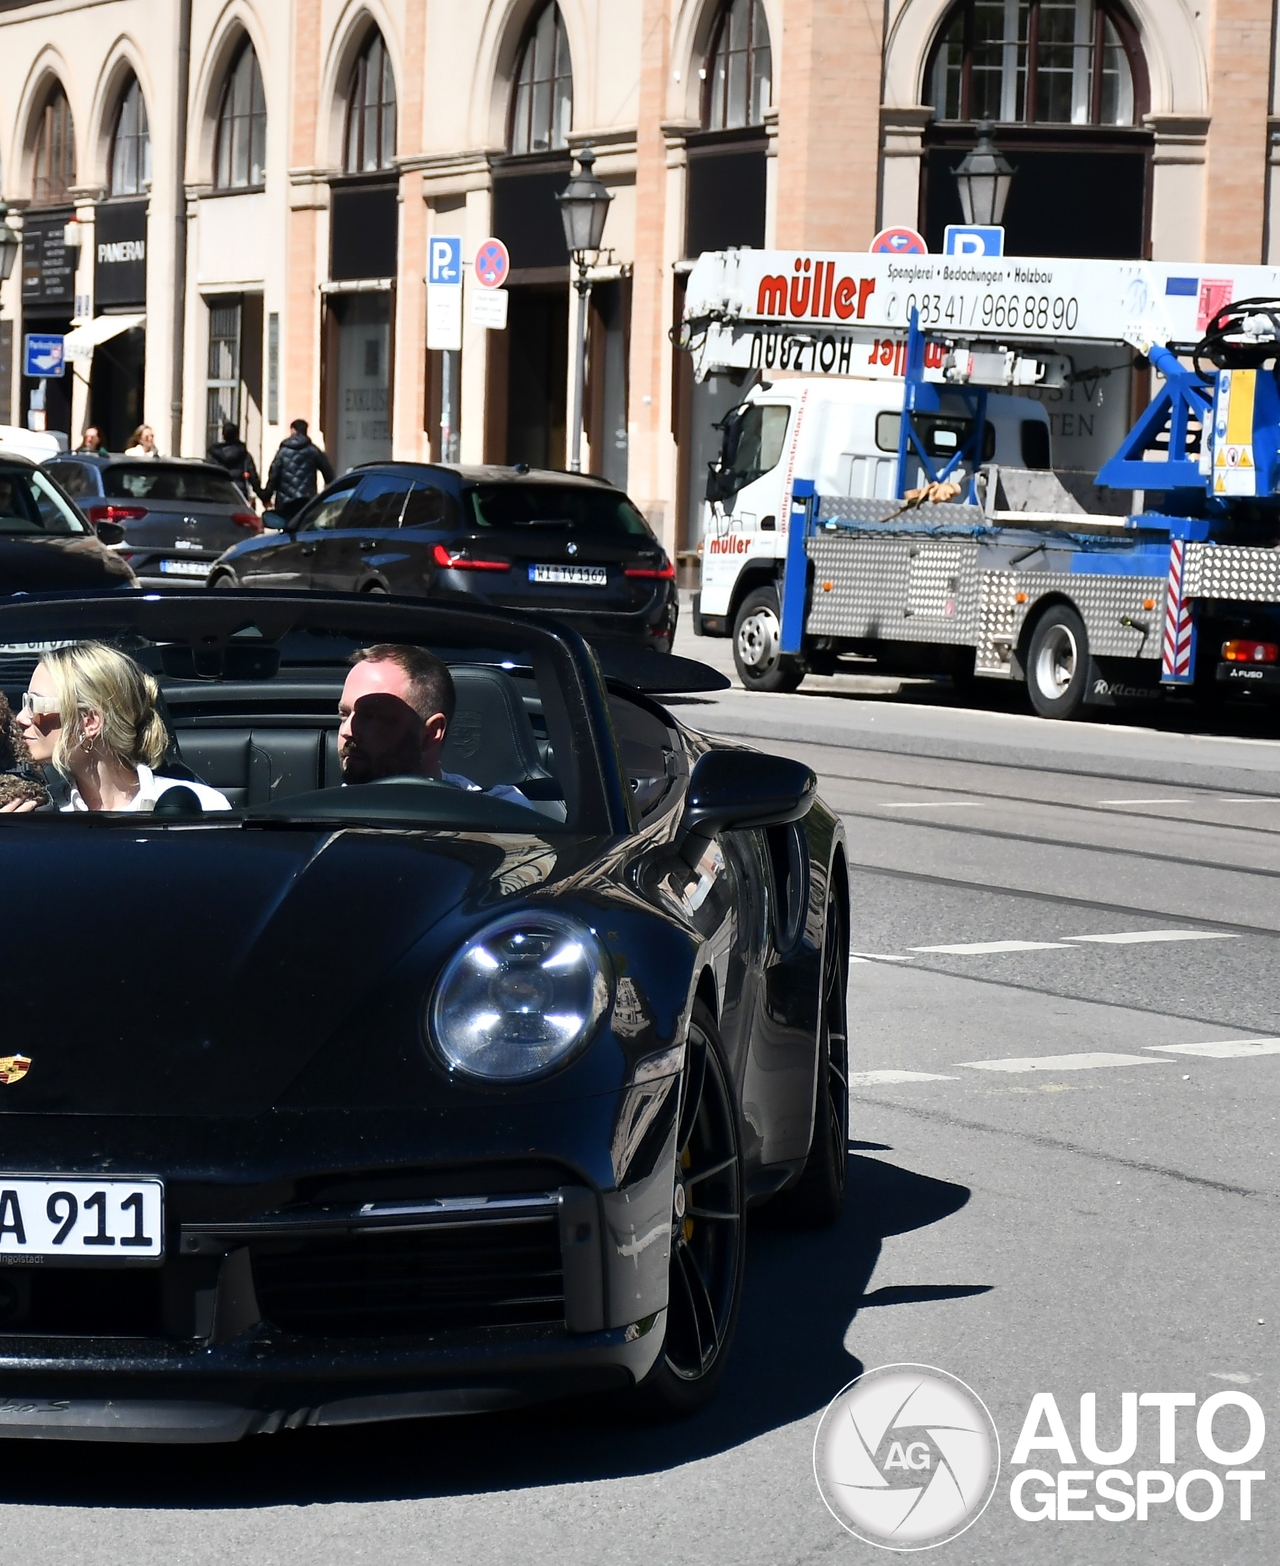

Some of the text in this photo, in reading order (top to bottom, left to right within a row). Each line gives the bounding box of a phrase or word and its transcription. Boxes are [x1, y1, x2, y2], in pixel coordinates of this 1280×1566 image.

[888, 263, 1053, 286] Spenglerei Bedachungen Holzbau
[756, 258, 876, 319] müller
[868, 337, 947, 376] mller
[710, 533, 752, 554] müller
[1238, 670, 1264, 679] FUSO
[46, 1190, 153, 1247] 911
[0, 1253, 44, 1265] Ingolstadt
